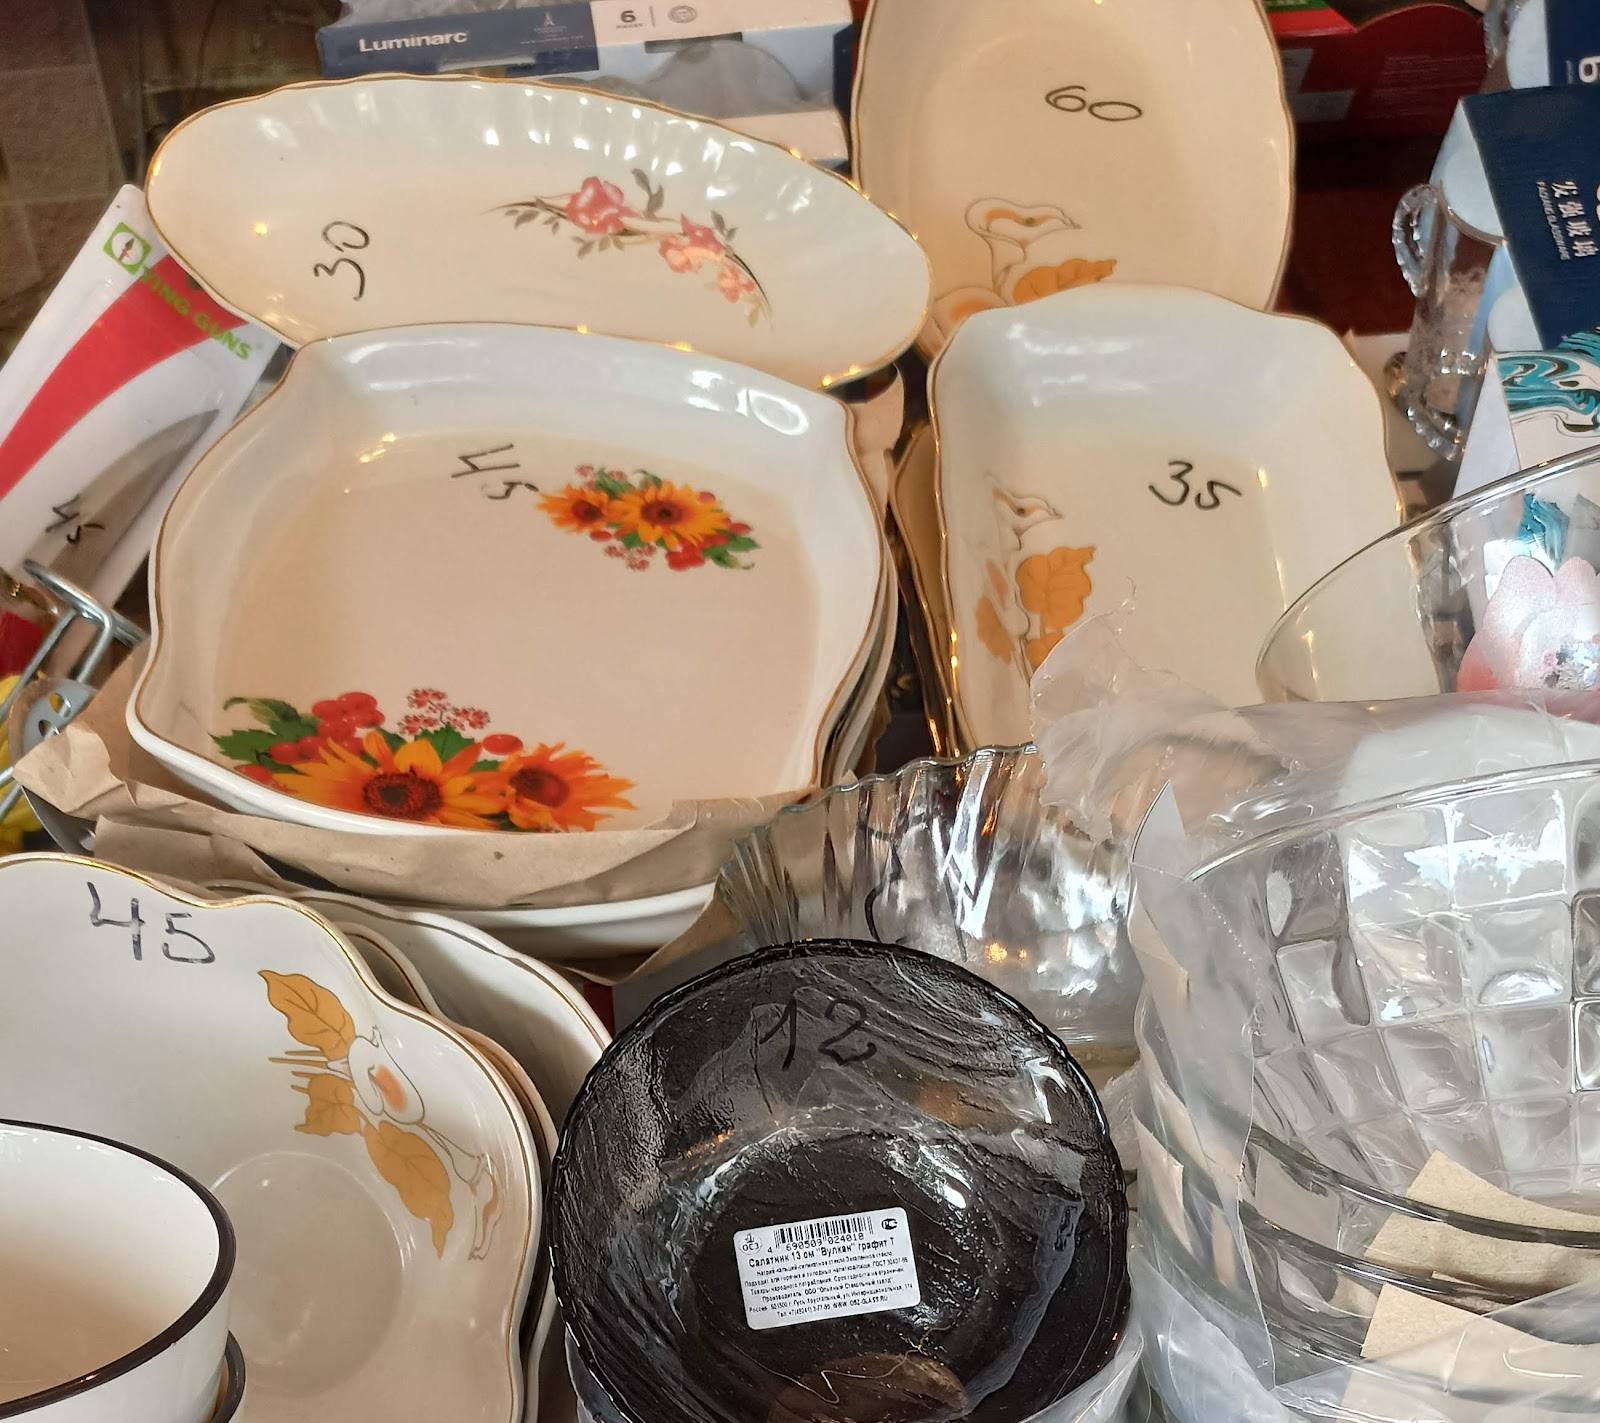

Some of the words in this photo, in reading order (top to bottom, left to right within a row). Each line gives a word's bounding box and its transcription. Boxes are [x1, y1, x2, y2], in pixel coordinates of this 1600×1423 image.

[359, 31, 467, 52] Luminarc
[619, 10, 636, 24] 6
[1045, 85, 1143, 122] 60
[313, 221, 370, 301] 30
[451, 444, 539, 500] 45
[1149, 460, 1243, 511] 35
[87, 880, 216, 964] 45
[760, 998, 877, 1068] 12
[748, 1252, 789, 1267] Салатник
[791, 1251, 801, 1260] 13
[803, 1250, 814, 1259] см
[816, 1241, 856, 1258] "Вулкан"
[857, 1237, 887, 1252] графит
